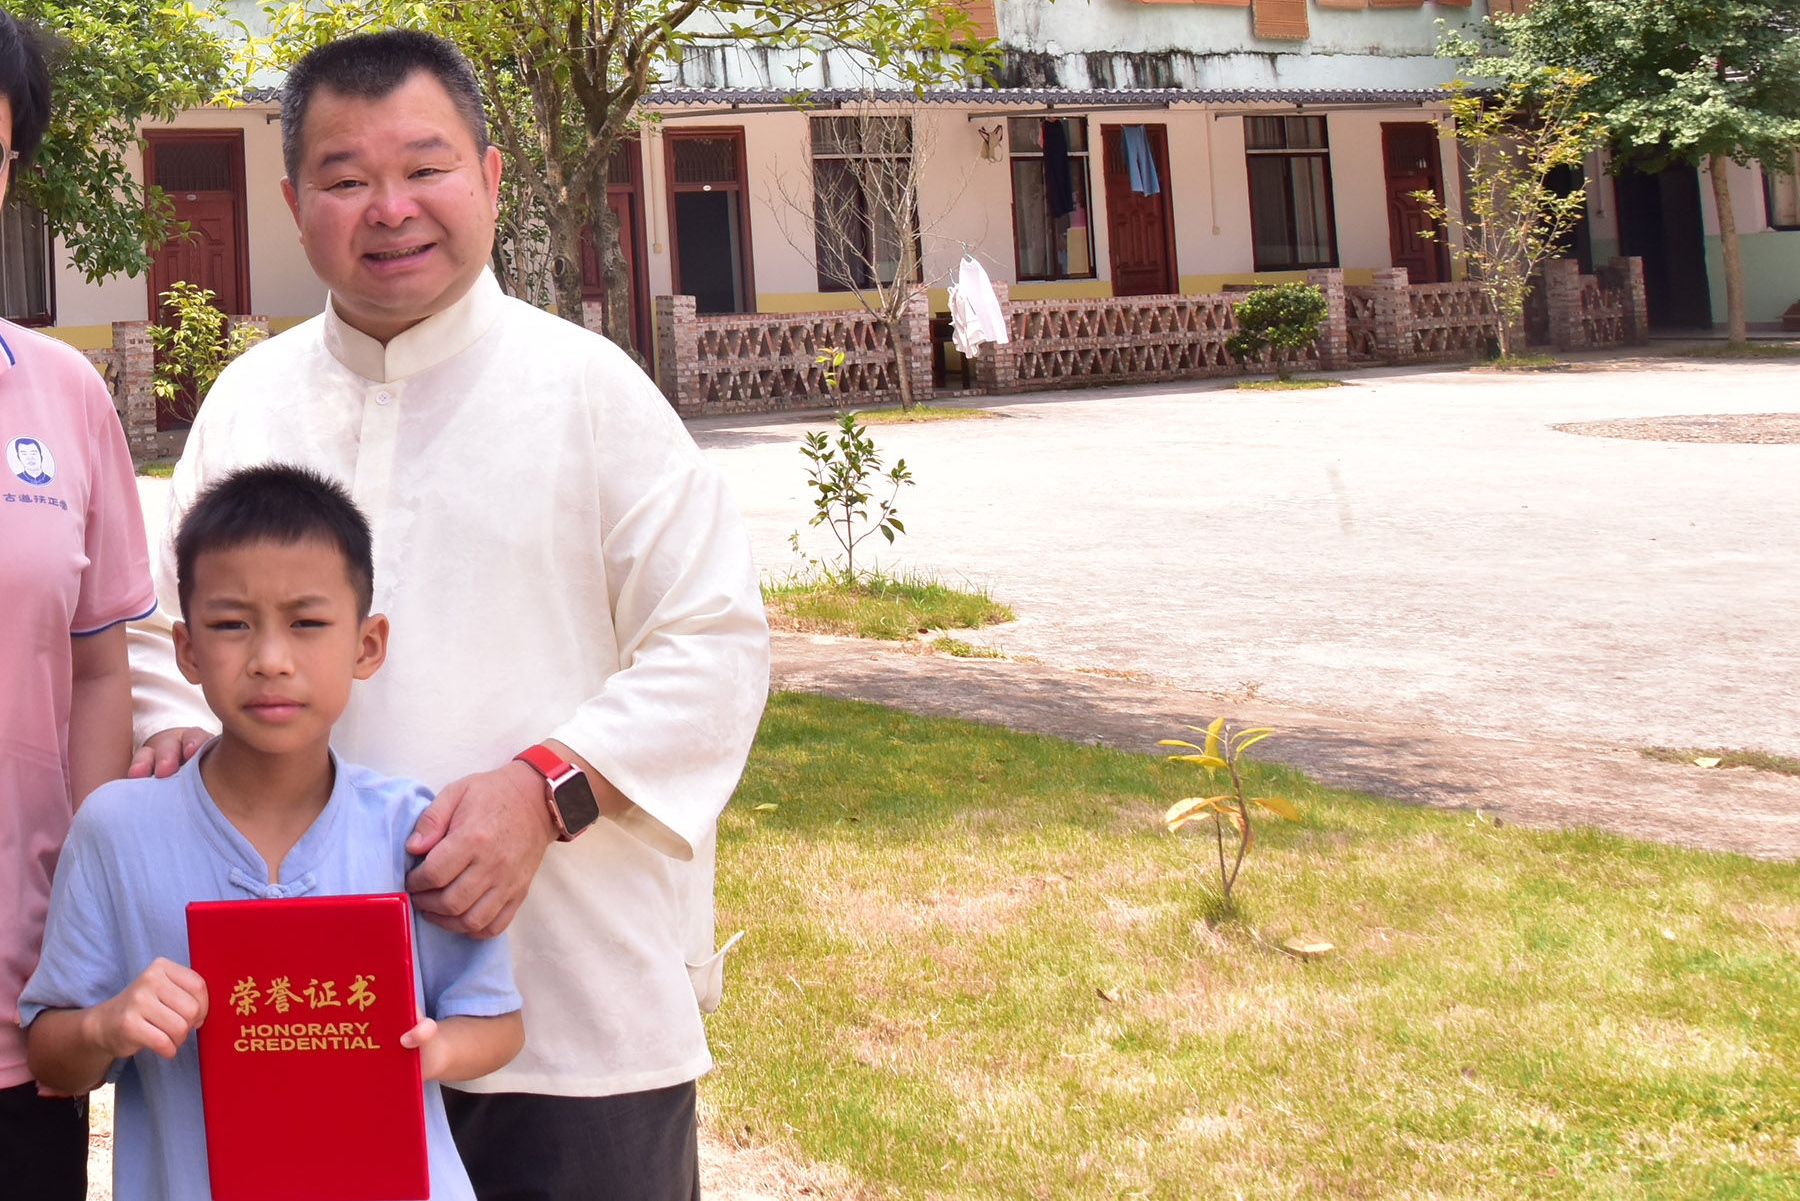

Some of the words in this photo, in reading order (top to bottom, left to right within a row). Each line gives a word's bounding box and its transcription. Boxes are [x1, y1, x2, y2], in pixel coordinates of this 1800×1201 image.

[229, 975, 377, 1016] 荣誉证书
[240, 1022, 370, 1038] HONORARY
[233, 1036, 381, 1053] CREDENTIAL
